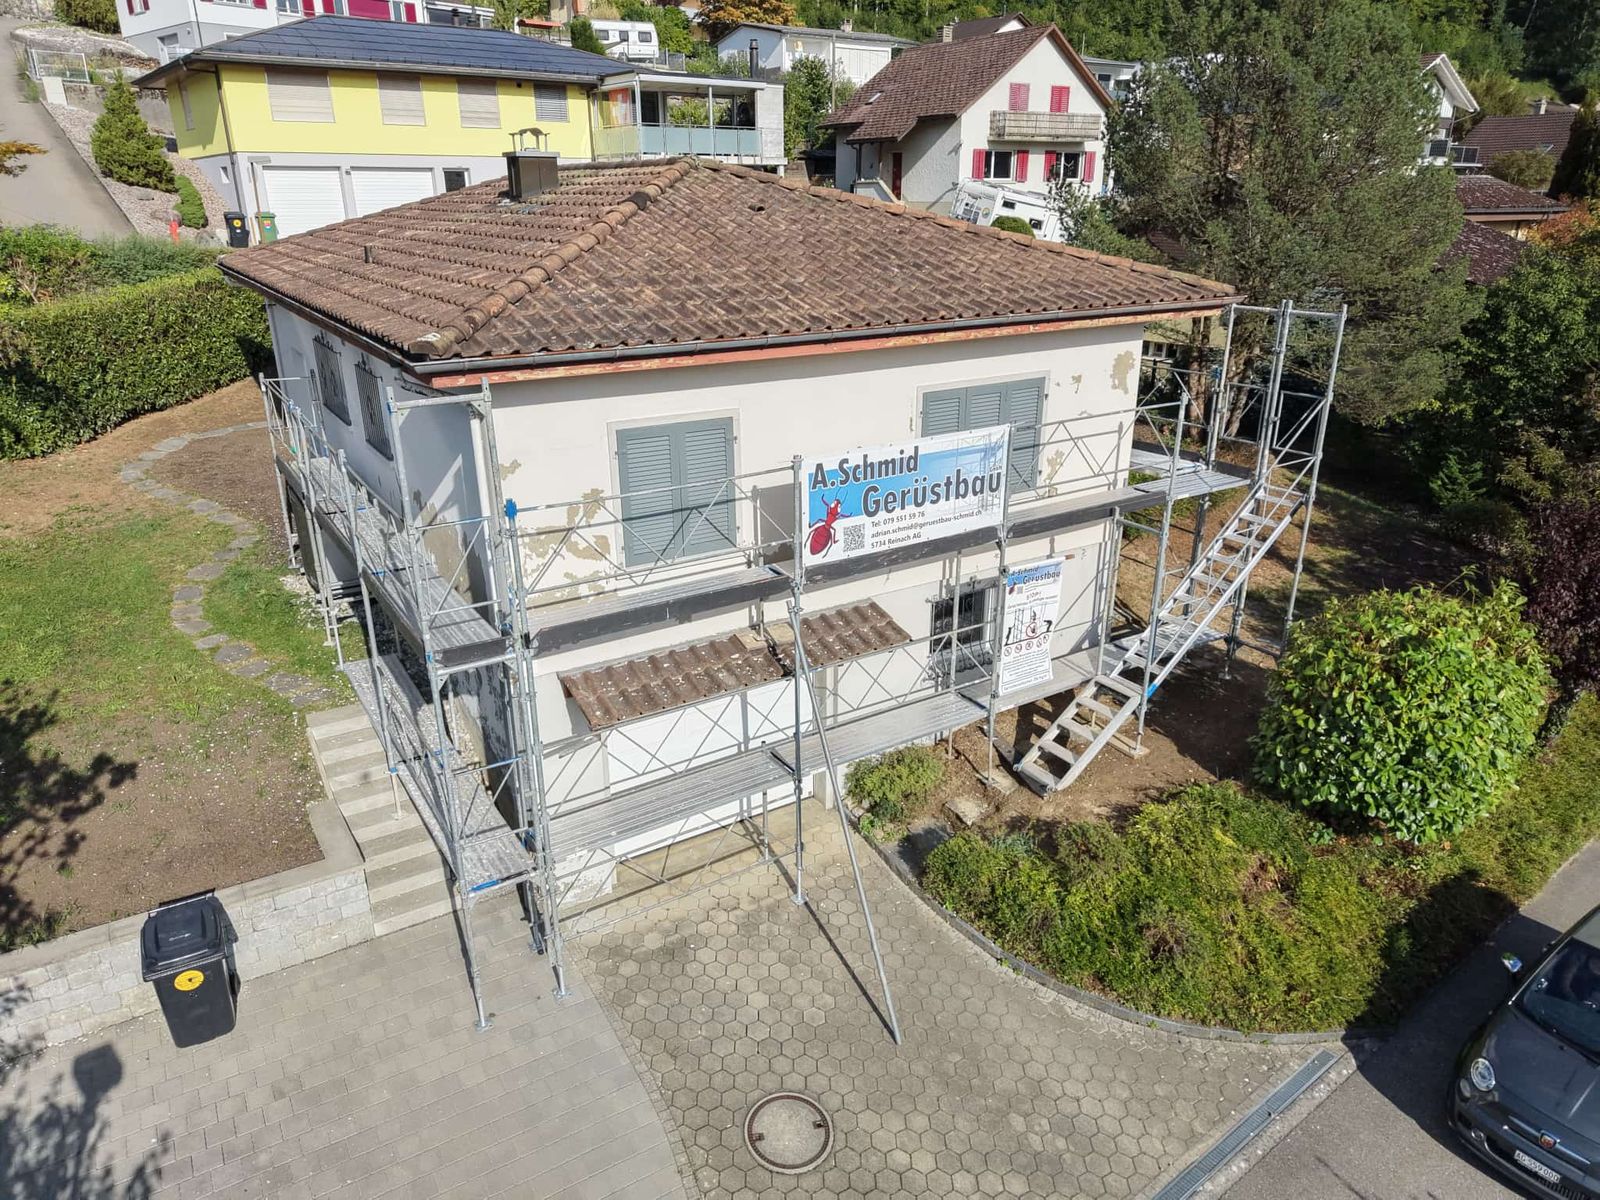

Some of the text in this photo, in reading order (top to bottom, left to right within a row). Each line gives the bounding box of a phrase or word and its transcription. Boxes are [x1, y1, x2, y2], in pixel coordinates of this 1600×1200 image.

[812, 446, 919, 489] A.Schmid
[862, 468, 1001, 518] Gerüstbau
[883, 517, 895, 526] 079
[896, 514, 907, 523] 551
[871, 541, 886, 549] 5734
[888, 535, 911, 545] Reinach
